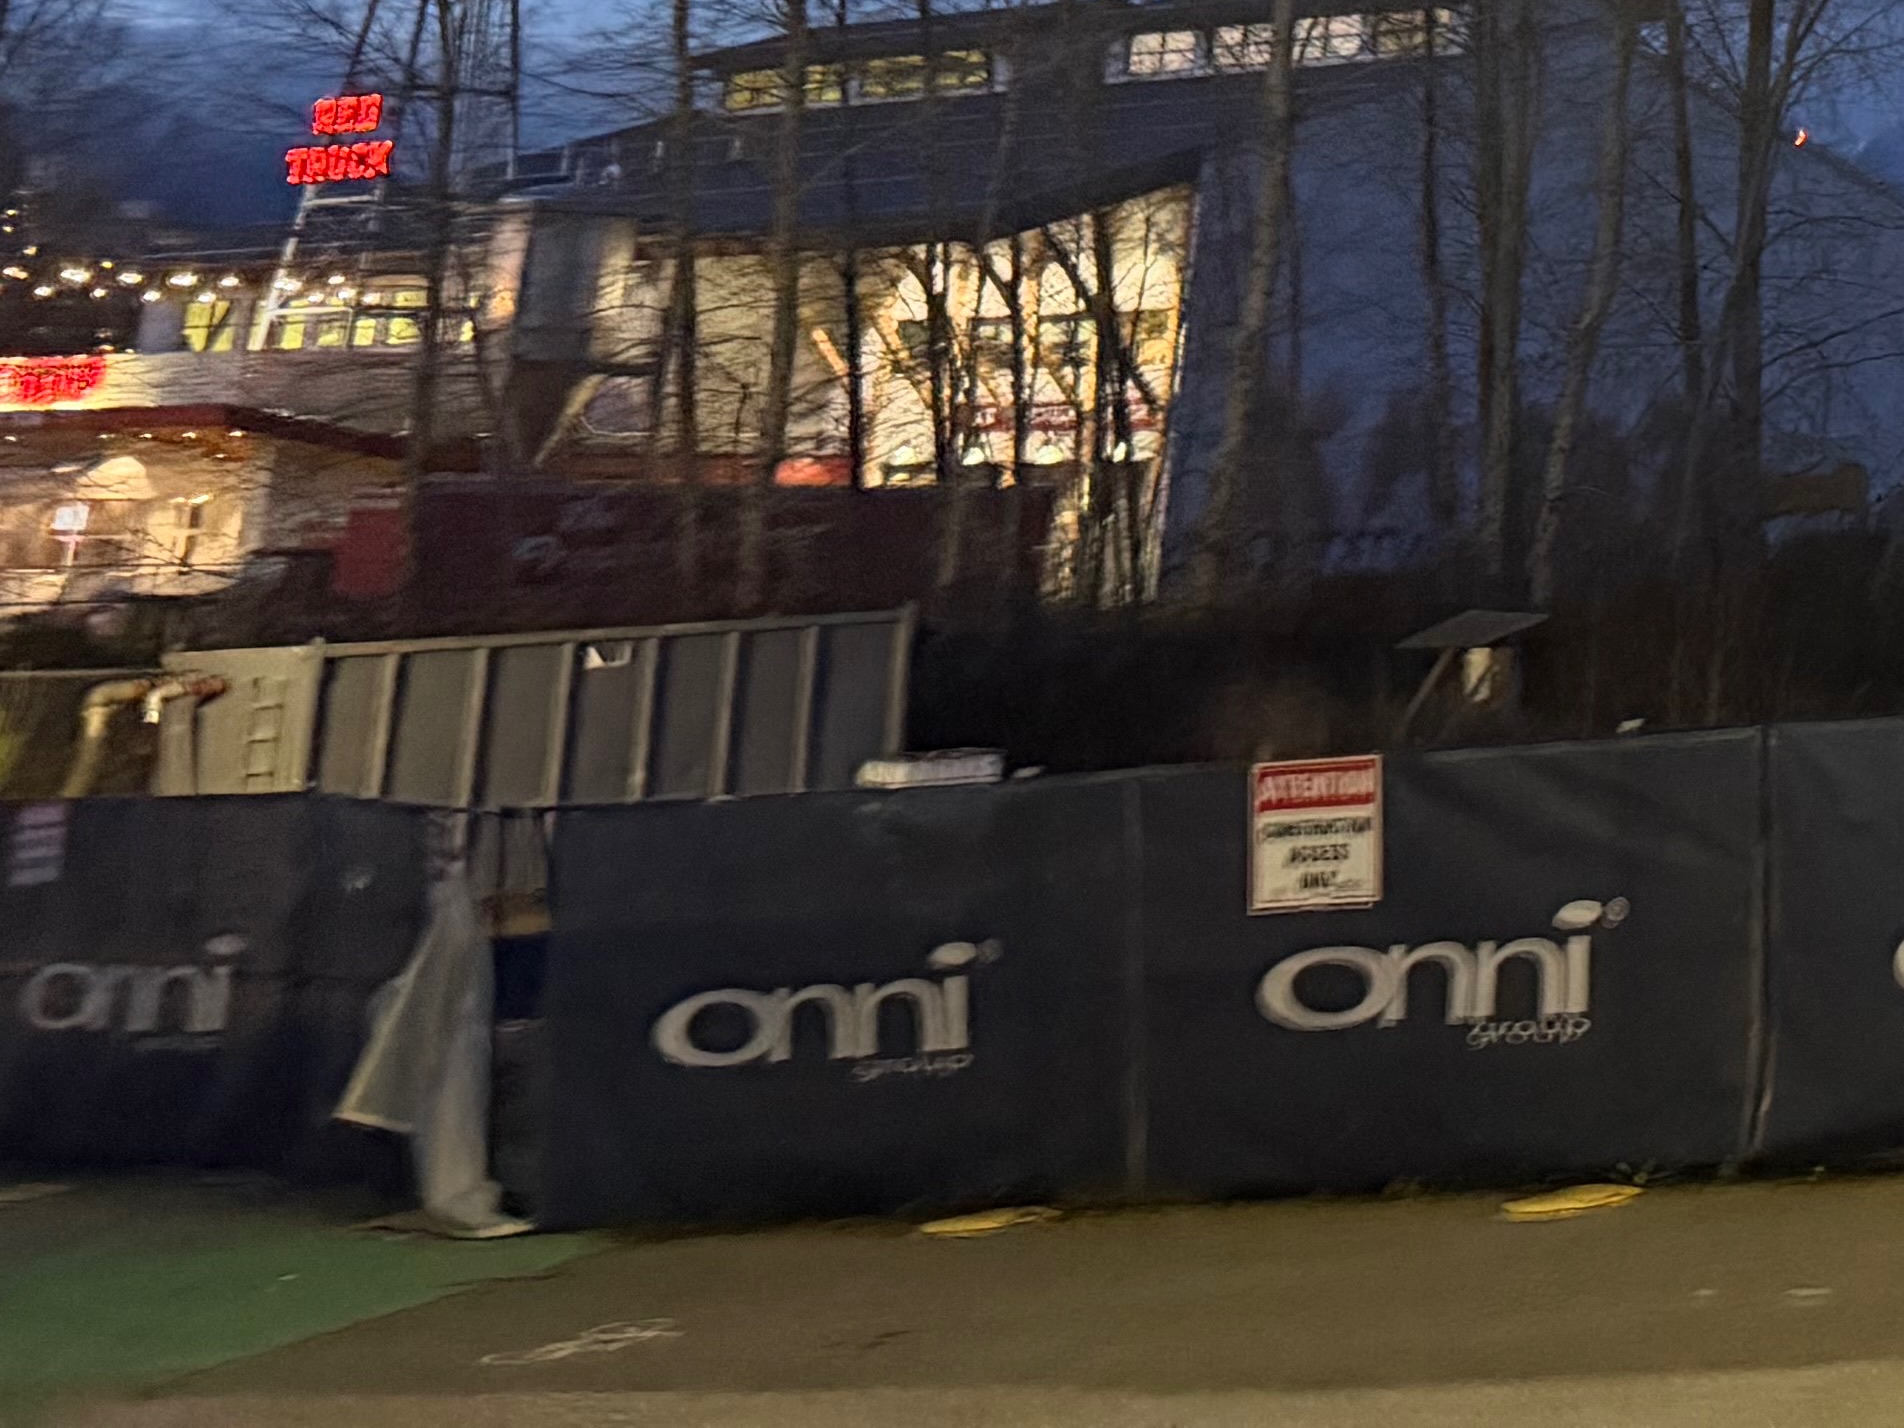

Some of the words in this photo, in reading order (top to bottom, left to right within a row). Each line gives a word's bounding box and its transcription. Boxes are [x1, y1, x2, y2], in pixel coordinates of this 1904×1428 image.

[285, 140, 393, 184] TRUCK
[1261, 768, 1375, 804] ATTENTION
[1255, 900, 1603, 1032] onni
[652, 941, 977, 1067] onni
[1466, 1016, 1591, 1050] group
